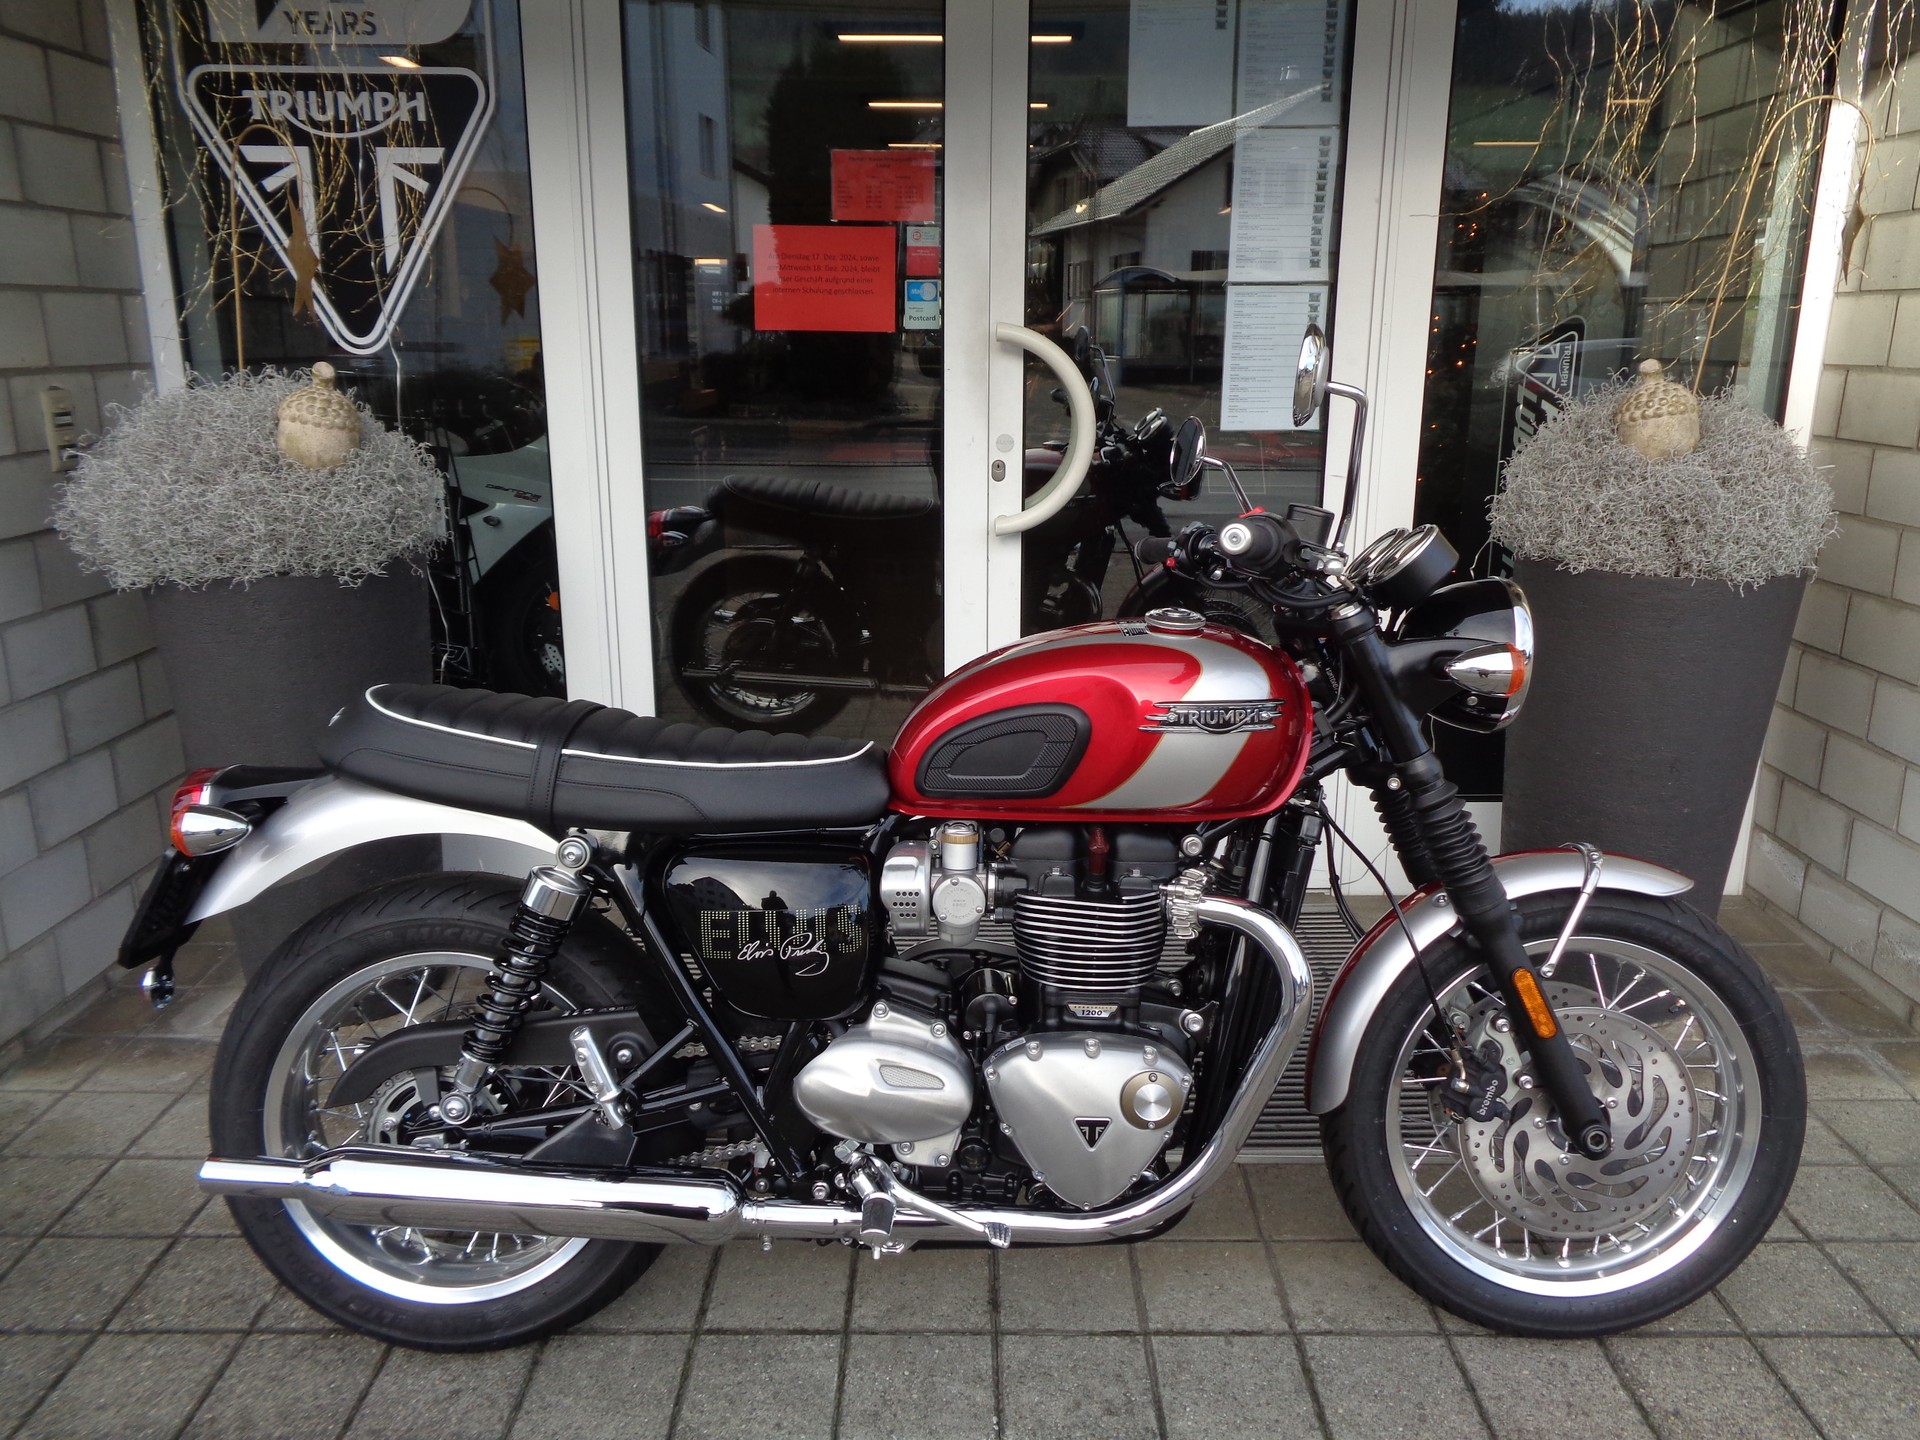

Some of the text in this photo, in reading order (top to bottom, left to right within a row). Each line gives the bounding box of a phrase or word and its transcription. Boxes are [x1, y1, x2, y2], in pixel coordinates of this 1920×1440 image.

[282, 10, 378, 36] YEARS
[242, 89, 427, 136] TRIUMPH
[780, 263, 811, 271] Mittwoch
[781, 252, 810, 261] Dienstag
[860, 254, 879, 262] sowie
[794, 275, 823, 283] Geschäft
[825, 276, 854, 285] aufgrund
[802, 286, 832, 295] Schulung
[908, 314, 937, 322] Postcard
[1558, 343, 1572, 387] TRIUMPH
[1175, 708, 1260, 731] TRIUMPH
[700, 904, 863, 960] ELVIS
[1475, 1078, 1499, 1116] brembo
